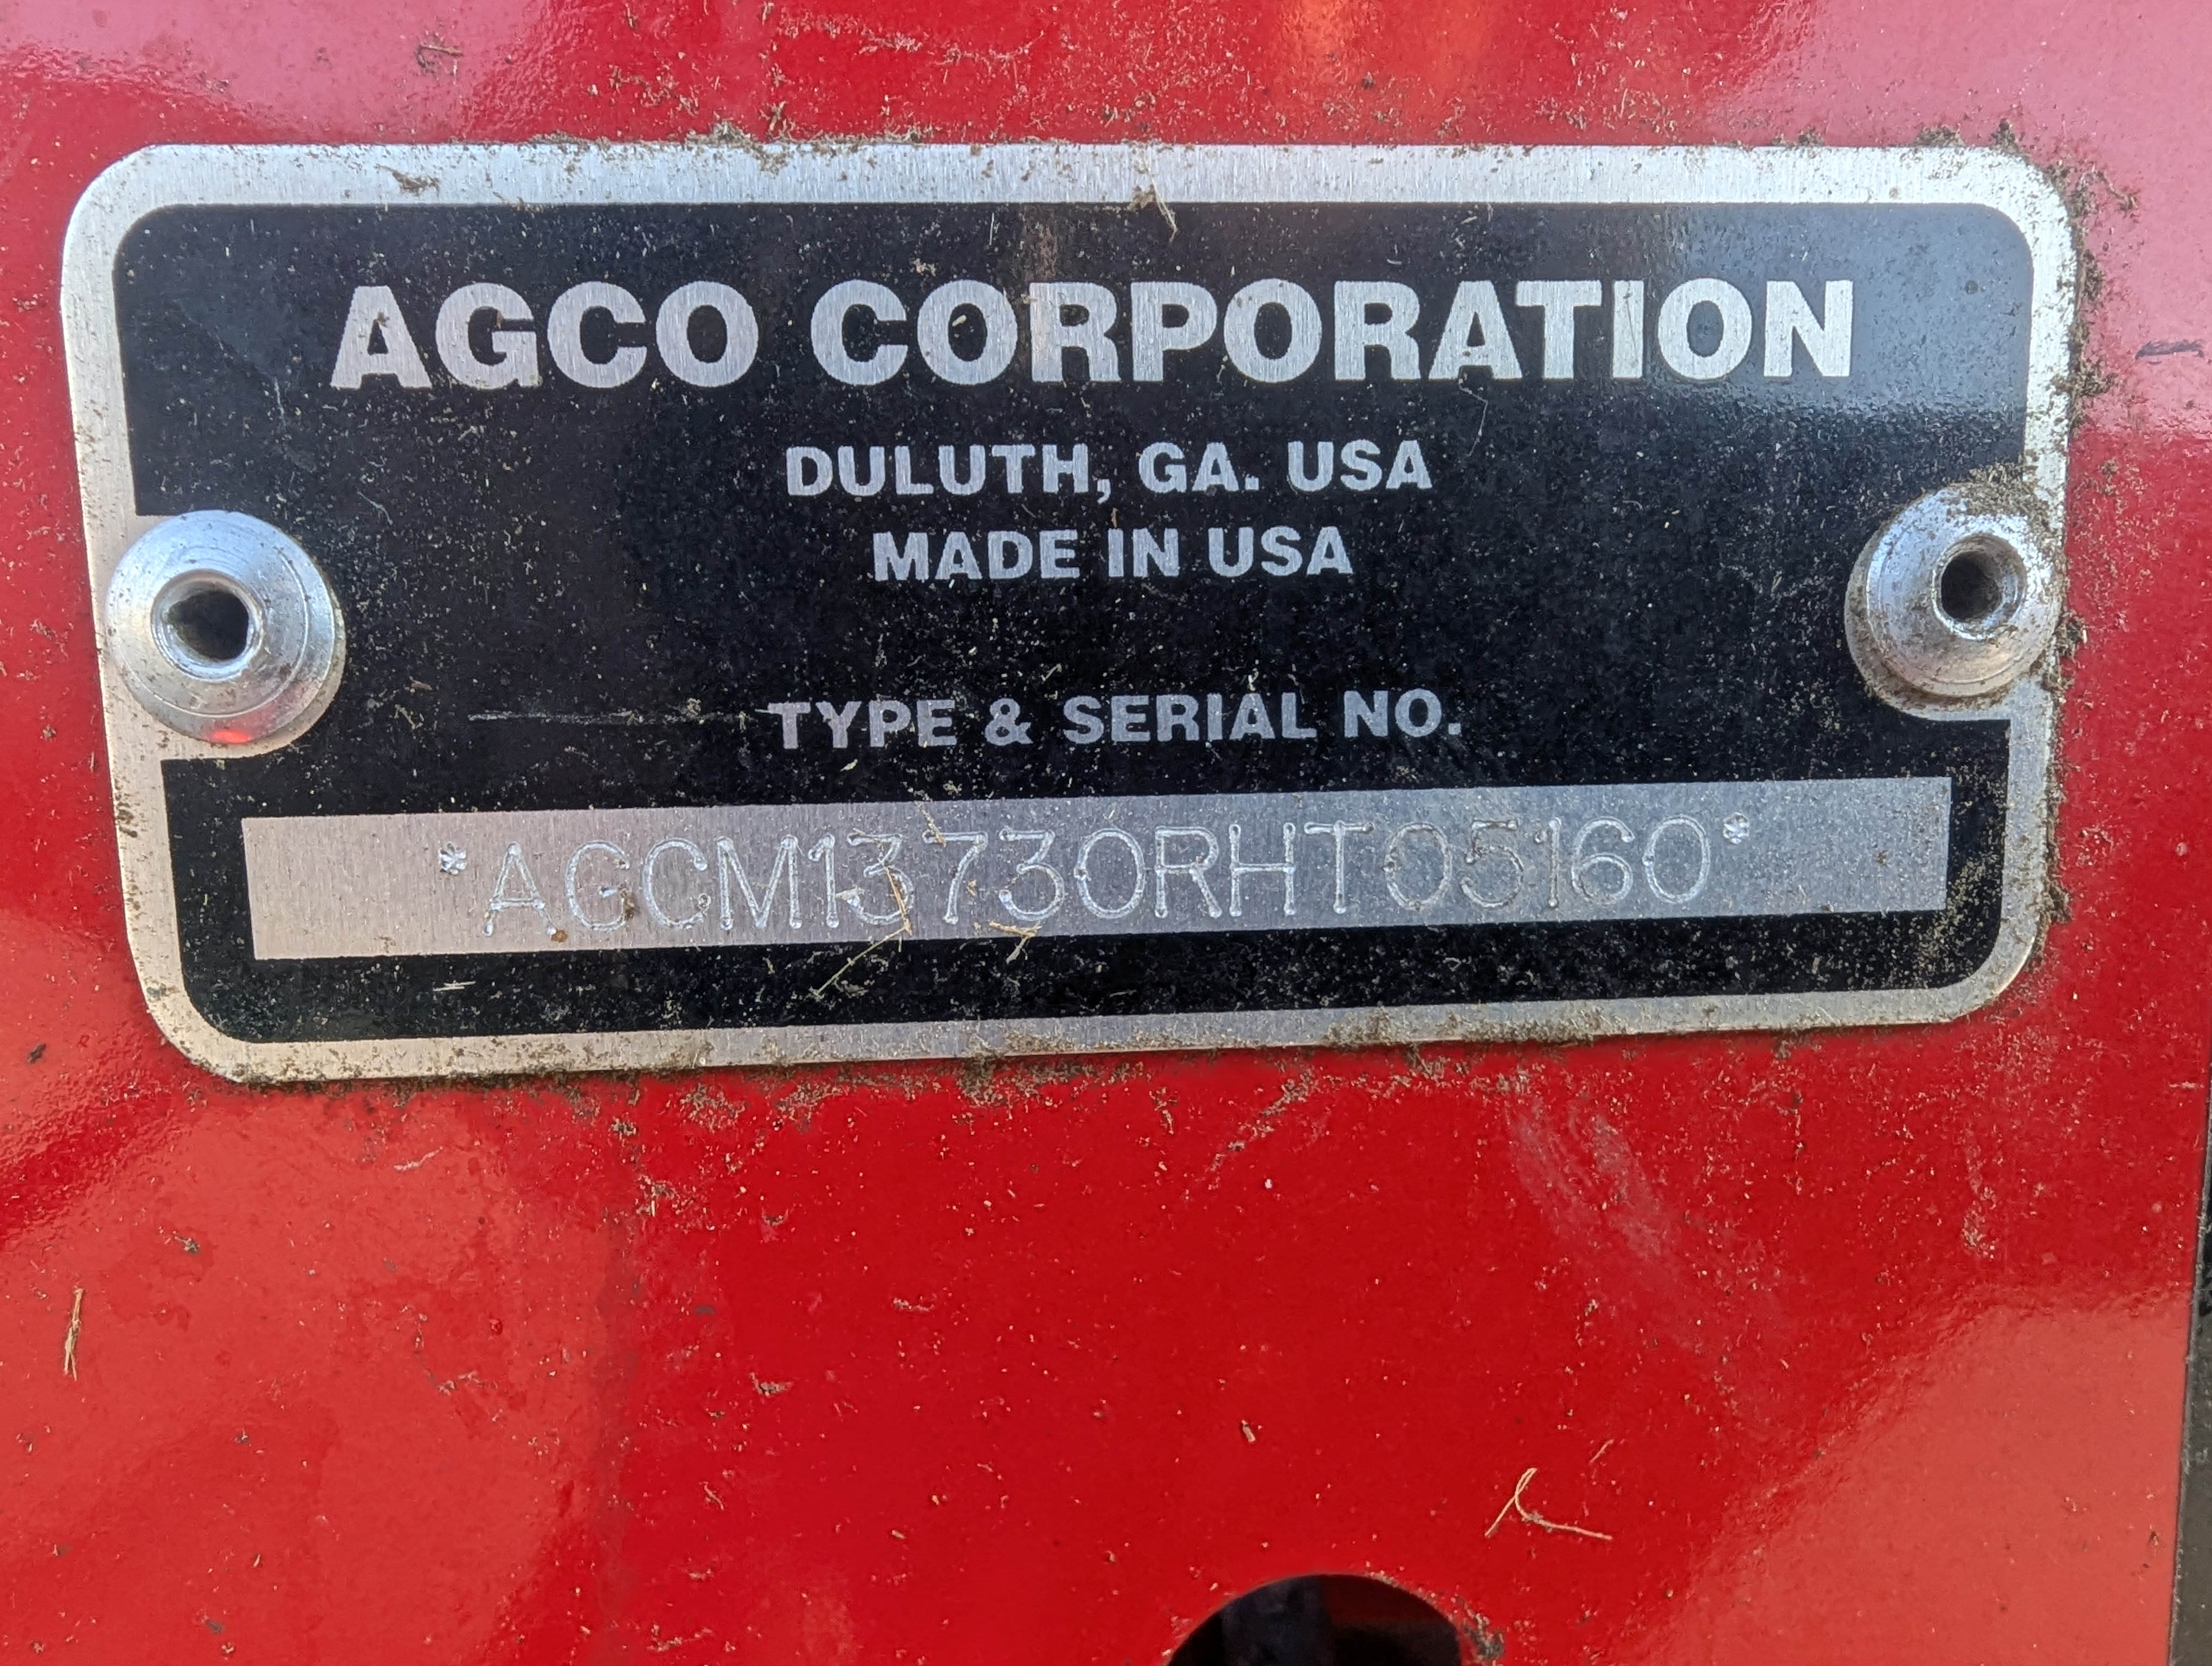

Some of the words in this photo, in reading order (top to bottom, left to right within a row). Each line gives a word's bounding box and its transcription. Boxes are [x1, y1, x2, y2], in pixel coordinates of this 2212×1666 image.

[330, 281, 758, 390] AGCO
[811, 278, 1851, 386] CORPORATION
[787, 444, 1110, 503] DULUTH,
[1137, 443, 1258, 493] GA.
[1288, 439, 1432, 491] USA
[874, 530, 1079, 582] MADE
[1108, 528, 1180, 577] IN
[1208, 527, 1353, 576] USA
[767, 699, 956, 749] TYPE
[986, 699, 1031, 745] &
[1065, 694, 1315, 743] SERIAL
[1345, 689, 1460, 737] NO.
